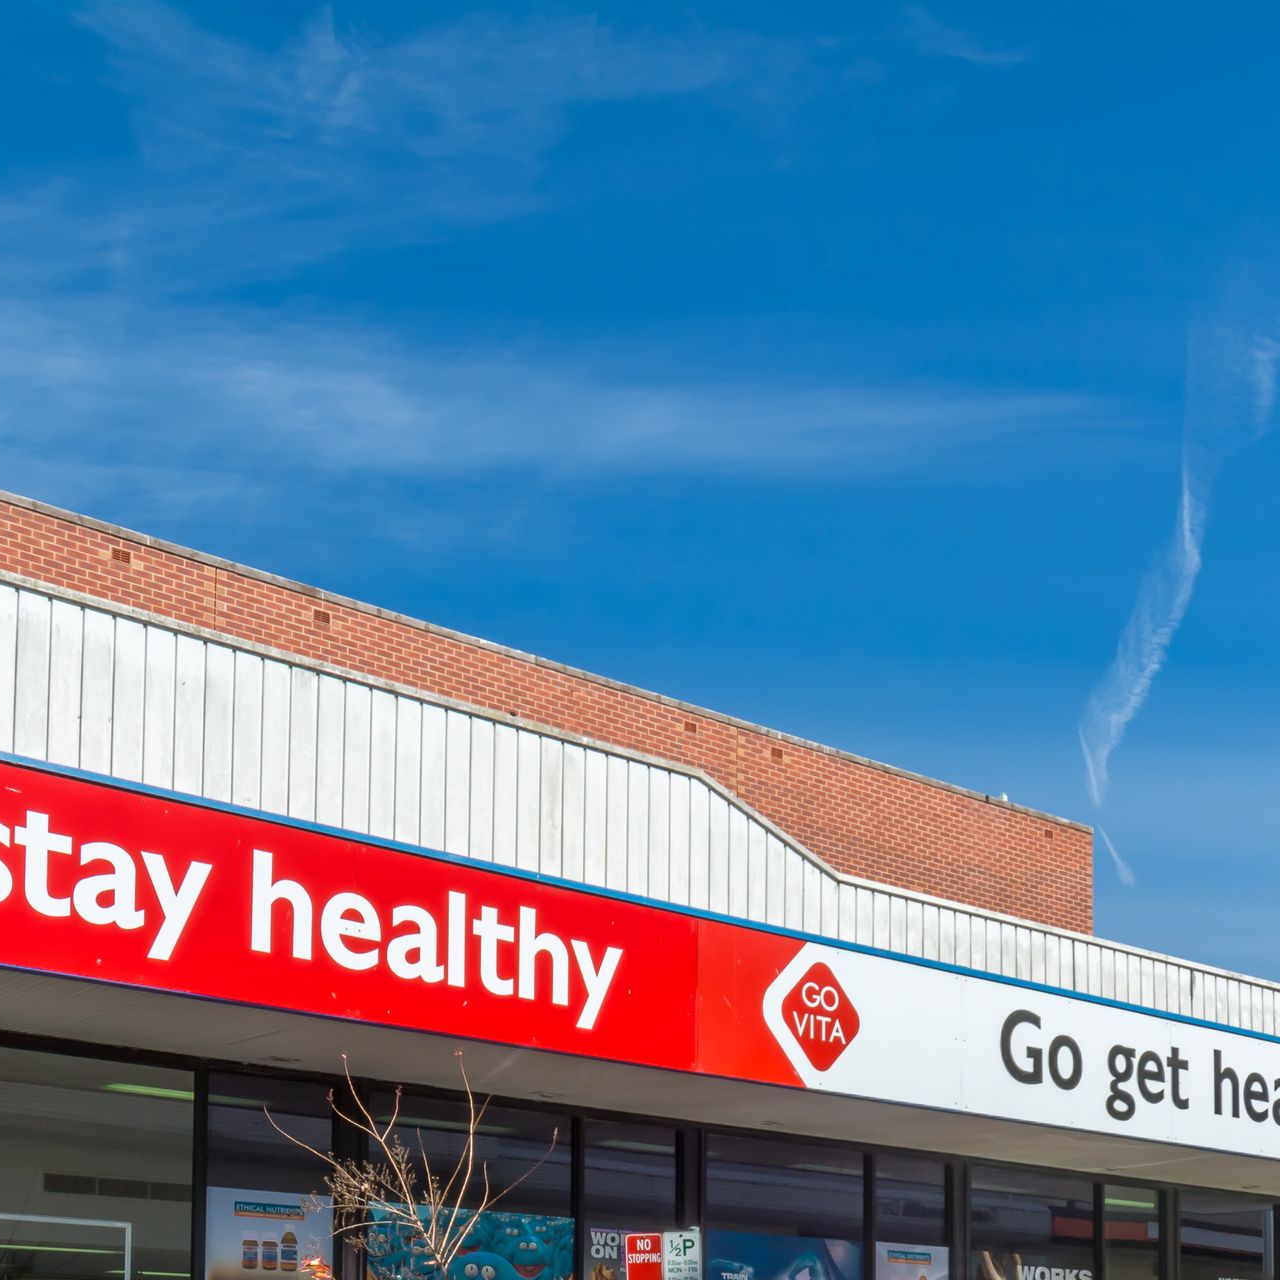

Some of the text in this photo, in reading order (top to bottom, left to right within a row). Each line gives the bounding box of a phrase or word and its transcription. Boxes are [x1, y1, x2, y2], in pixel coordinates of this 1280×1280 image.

[250, 848, 624, 1031] healthy
[801, 981, 840, 1009] GO
[792, 1010, 847, 1046] VITA
[999, 1008, 1084, 1092] Go
[1105, 1045, 1190, 1122] get
[590, 1245, 618, 1259] ON
[636, 1239, 651, 1250] NO
[628, 1252, 661, 1264] STOPPING
[721, 1272, 748, 1280] TRAIN
